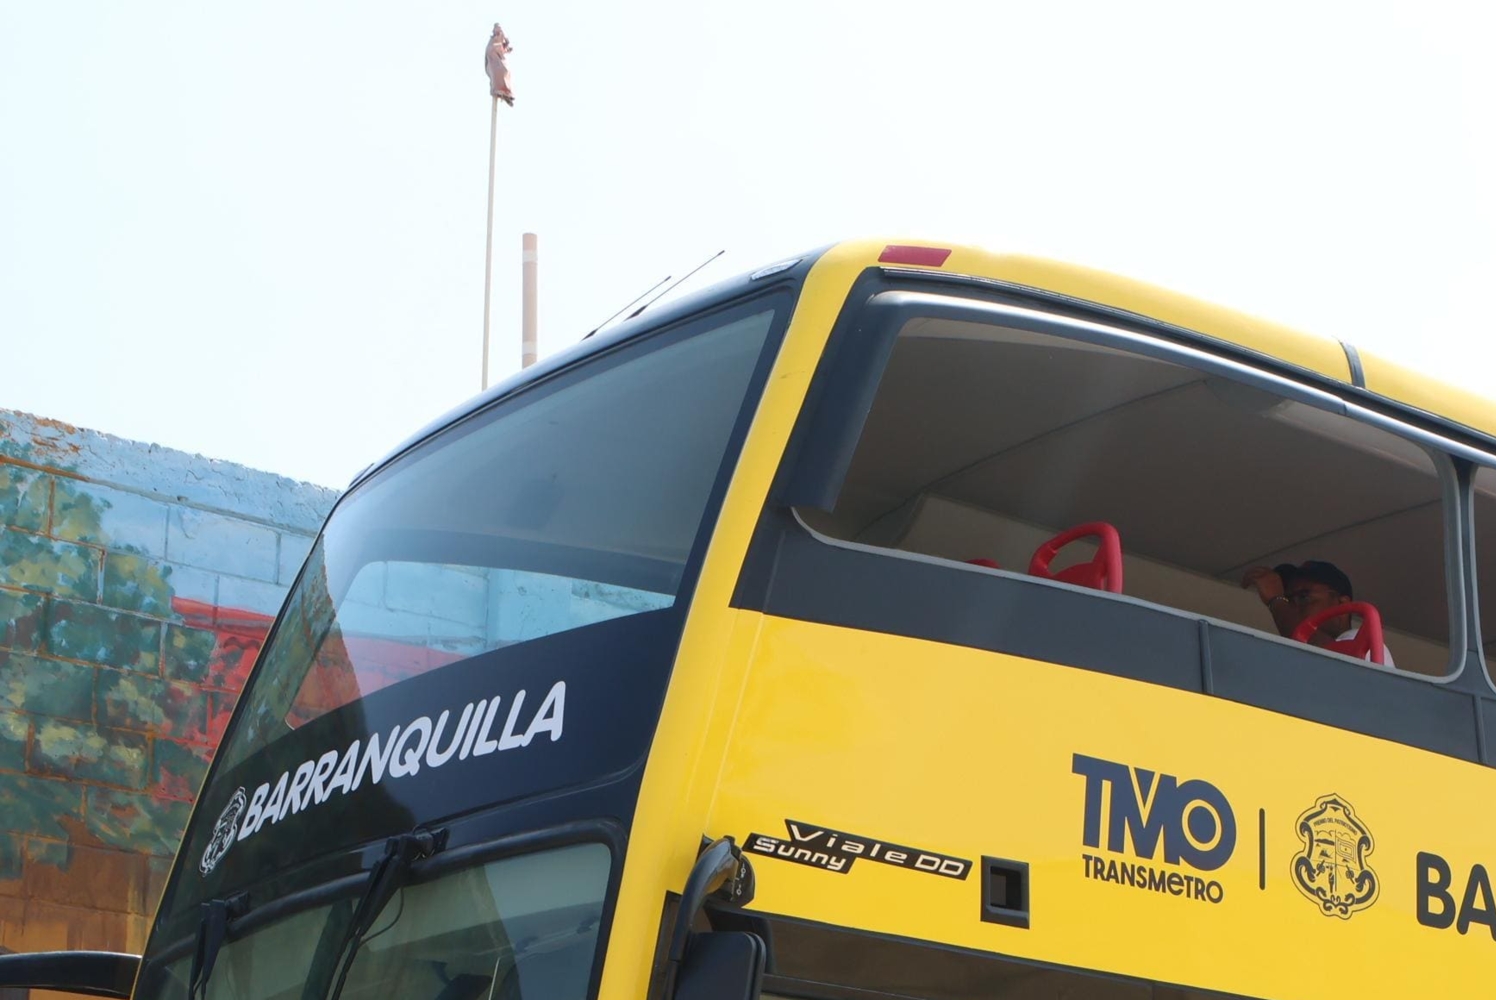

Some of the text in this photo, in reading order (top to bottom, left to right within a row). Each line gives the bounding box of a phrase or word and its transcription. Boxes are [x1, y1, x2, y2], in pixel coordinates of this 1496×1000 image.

[237, 681, 566, 841] BARRANQUILLA
[753, 837, 846, 871] Sunny
[790, 824, 965, 876] Viale DD
[1072, 753, 1237, 872] TMO
